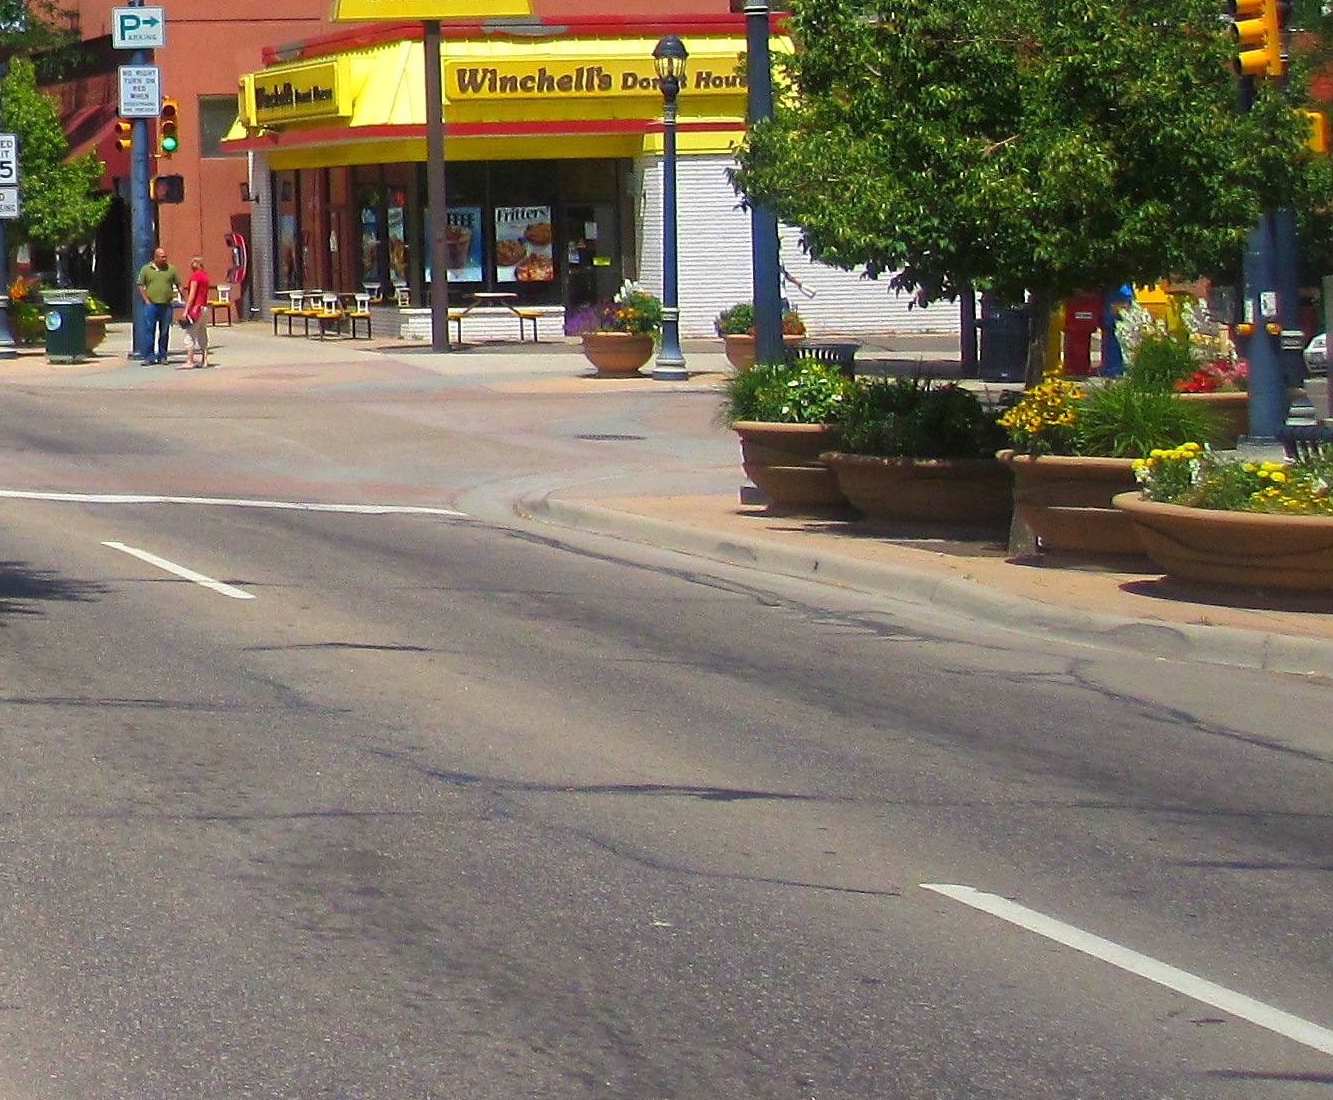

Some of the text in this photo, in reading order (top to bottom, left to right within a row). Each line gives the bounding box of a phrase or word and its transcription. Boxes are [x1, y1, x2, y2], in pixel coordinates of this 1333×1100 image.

[457, 66, 748, 93] Winchell's Dont Hou
